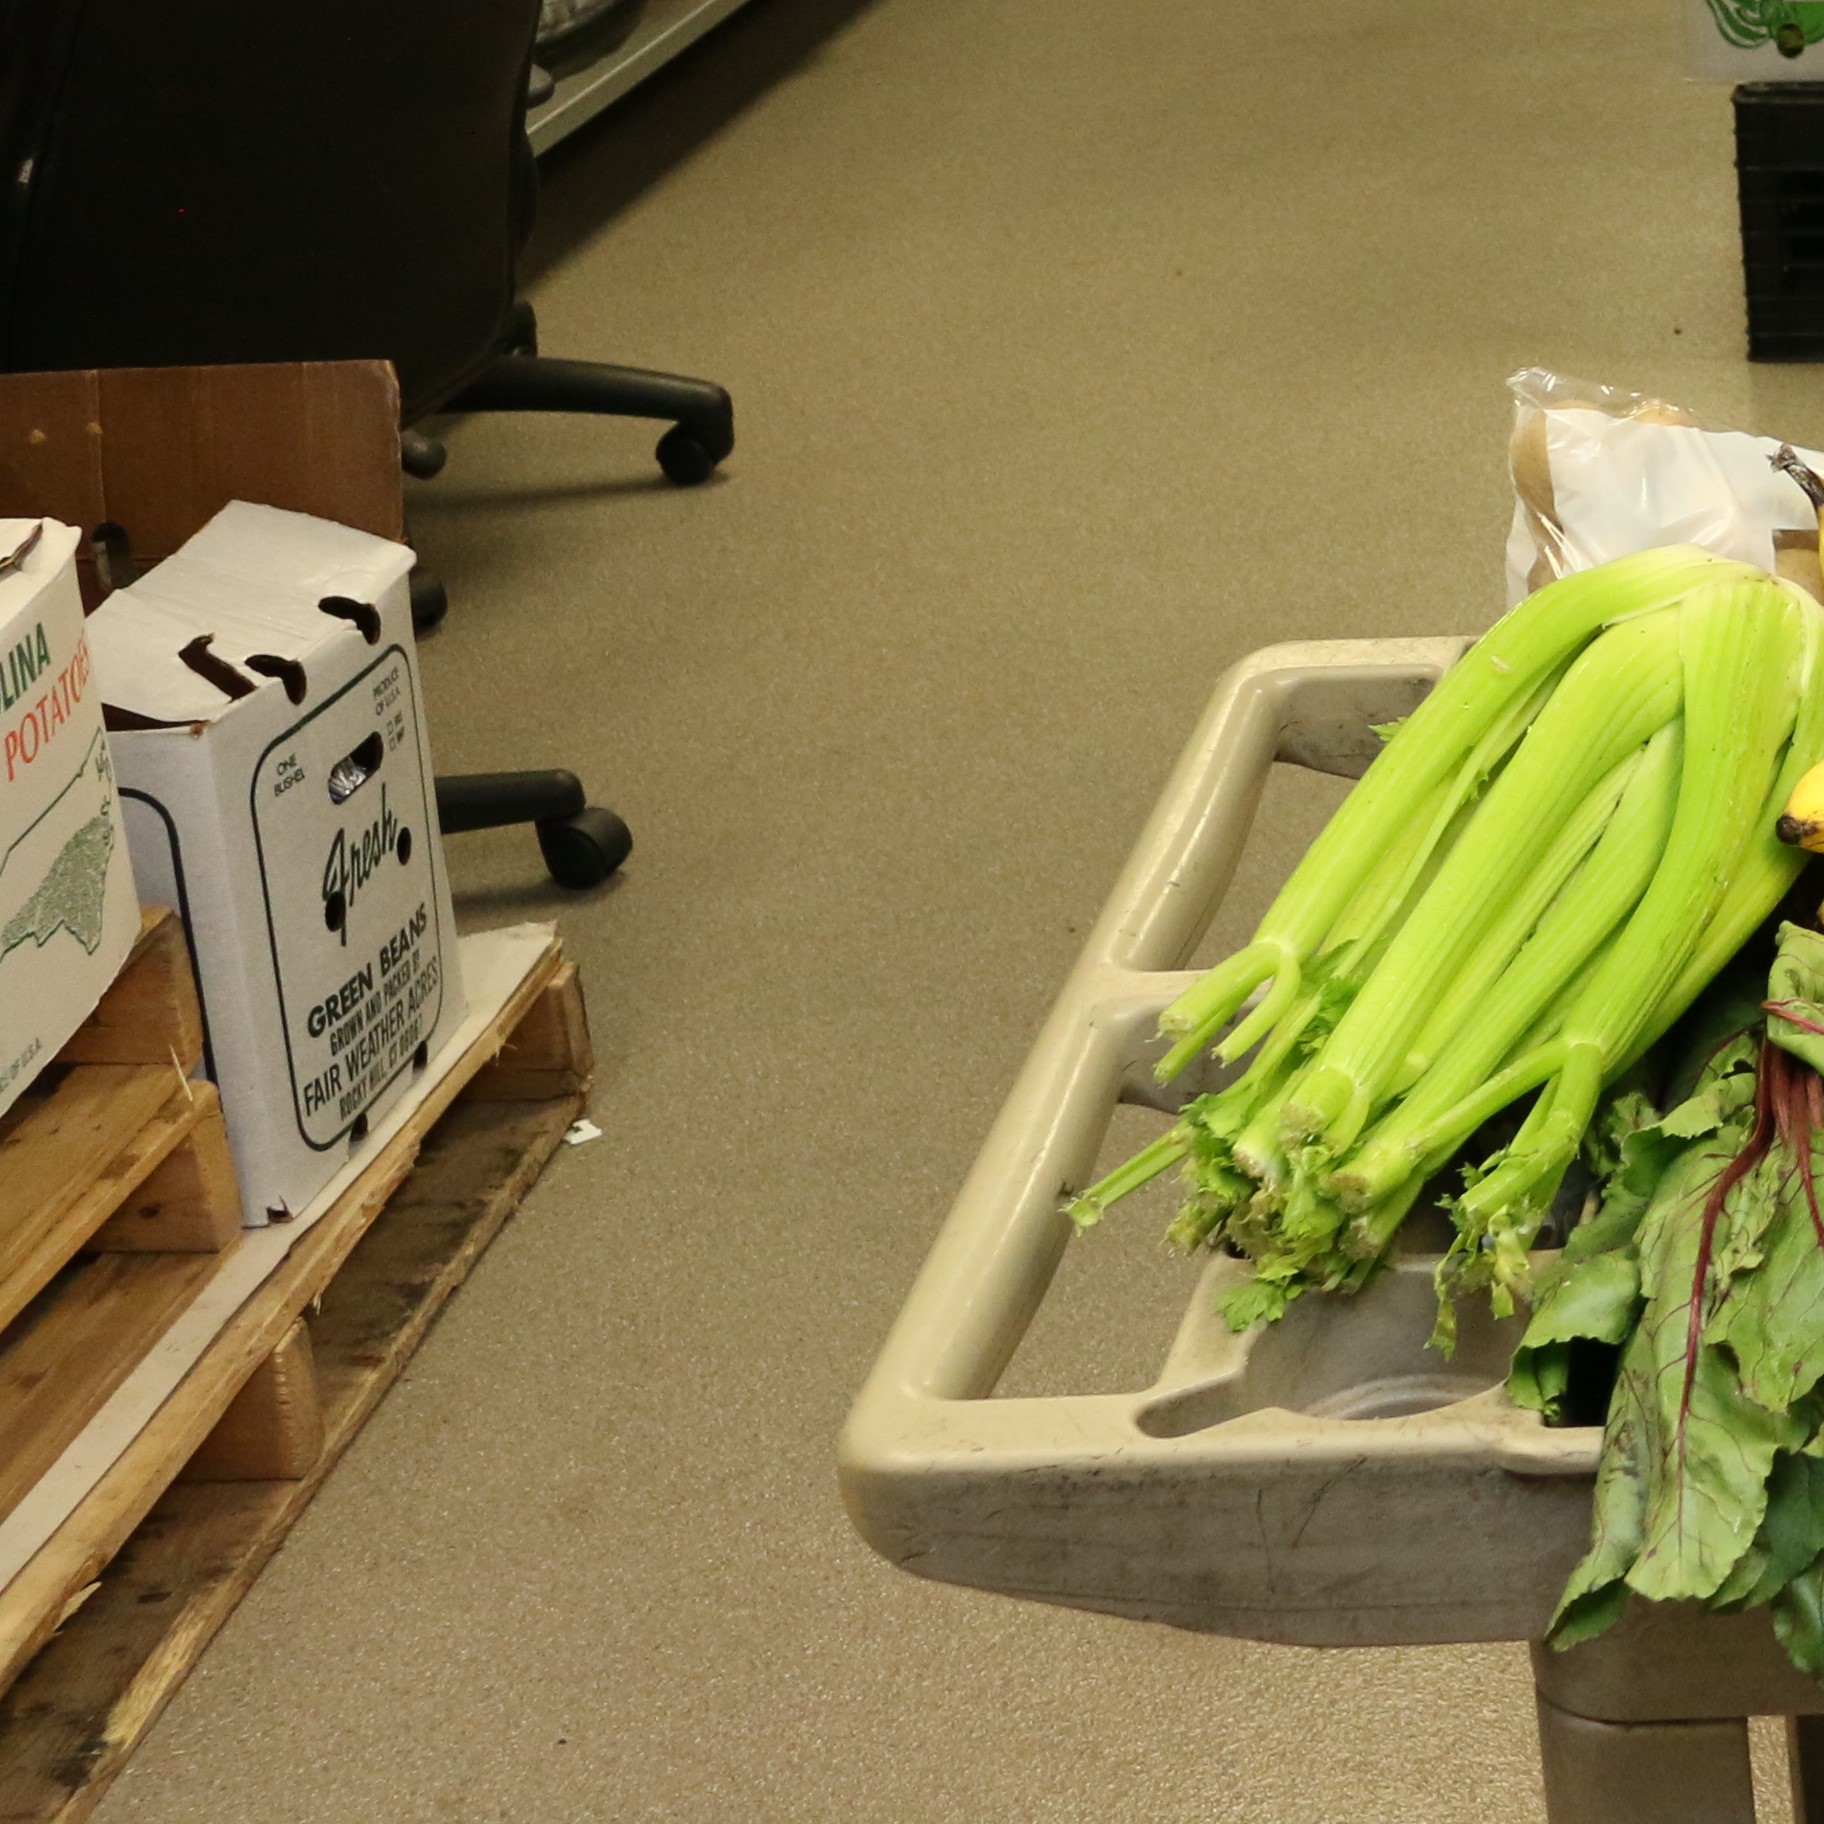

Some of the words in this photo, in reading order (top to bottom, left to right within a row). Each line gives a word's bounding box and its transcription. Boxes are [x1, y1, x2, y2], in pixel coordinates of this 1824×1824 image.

[0, 622, 51, 711] LINA
[276, 752, 297, 777] ONE
[321, 782, 400, 946] Fresh
[307, 961, 374, 1039] GREEN
[379, 902, 427, 978] BEANS
[330, 1014, 364, 1057] GROWN
[365, 990, 382, 1027] AND
[303, 1063, 342, 1117] FAIR
[345, 998, 405, 1082] WEATHER
[408, 955, 439, 1015] ACRES
